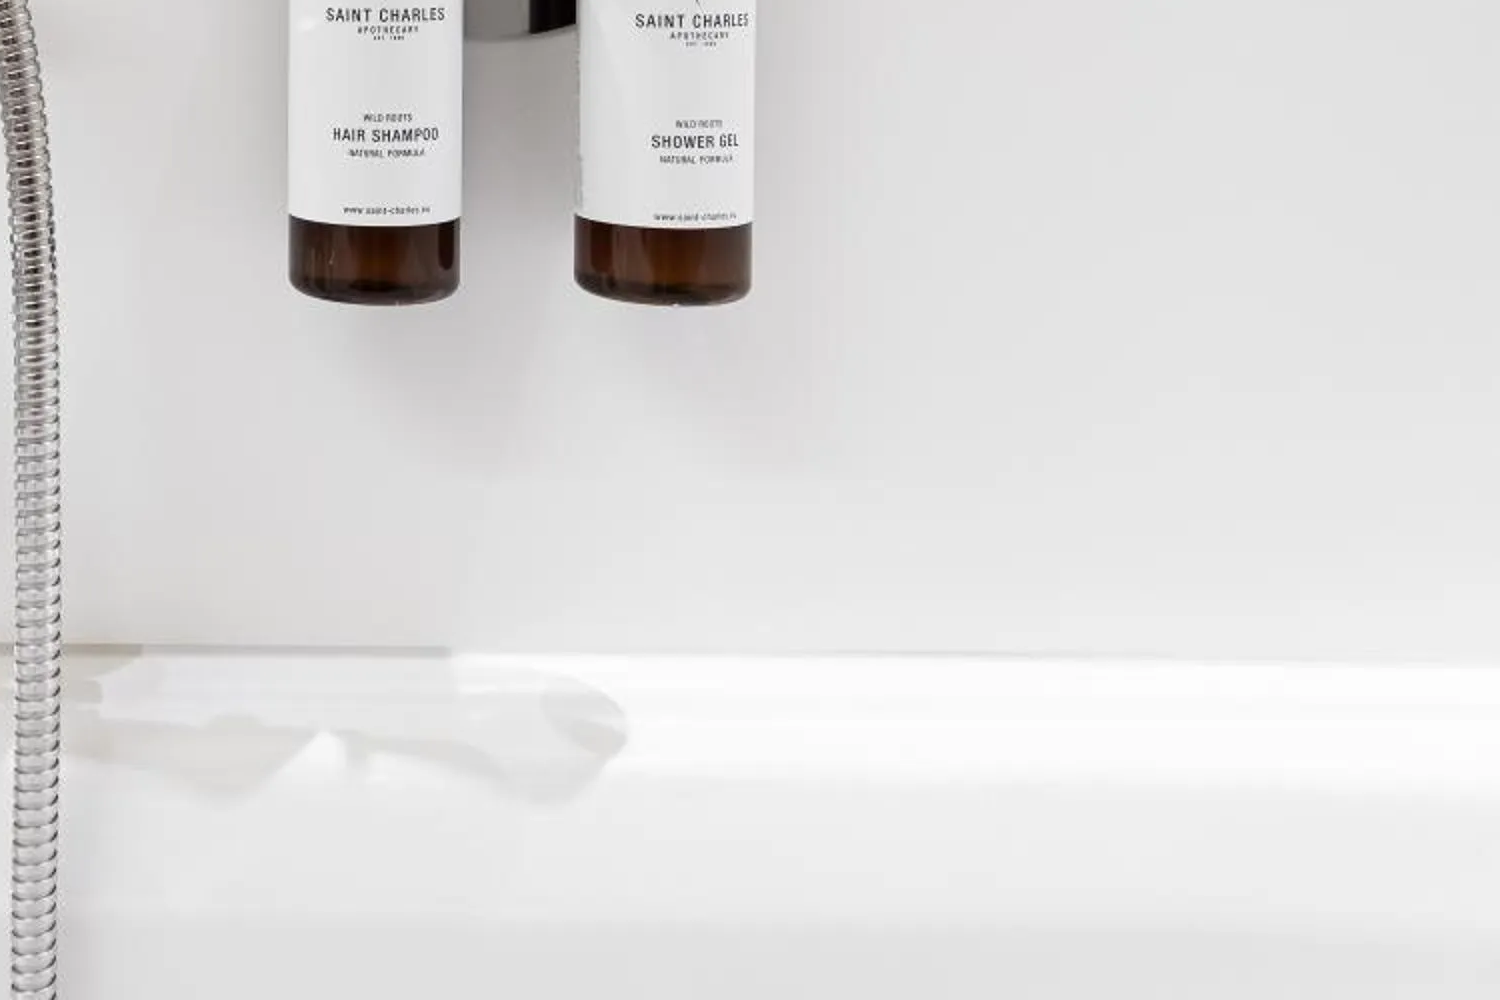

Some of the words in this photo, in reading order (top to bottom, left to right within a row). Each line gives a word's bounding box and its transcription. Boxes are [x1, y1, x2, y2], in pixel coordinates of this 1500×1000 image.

[325, 7, 372, 22] SAINT
[379, 7, 446, 22] CHARLES
[635, 13, 685, 28] SAINT
[692, 13, 749, 28] CHARLES
[357, 26, 419, 34] APOTHECARY
[669, 32, 730, 40] APOTHECARY
[333, 127, 365, 142] HAIR
[371, 127, 440, 142] SHAMPOO
[651, 135, 715, 149] SHOWER
[718, 133, 739, 148] GEL
